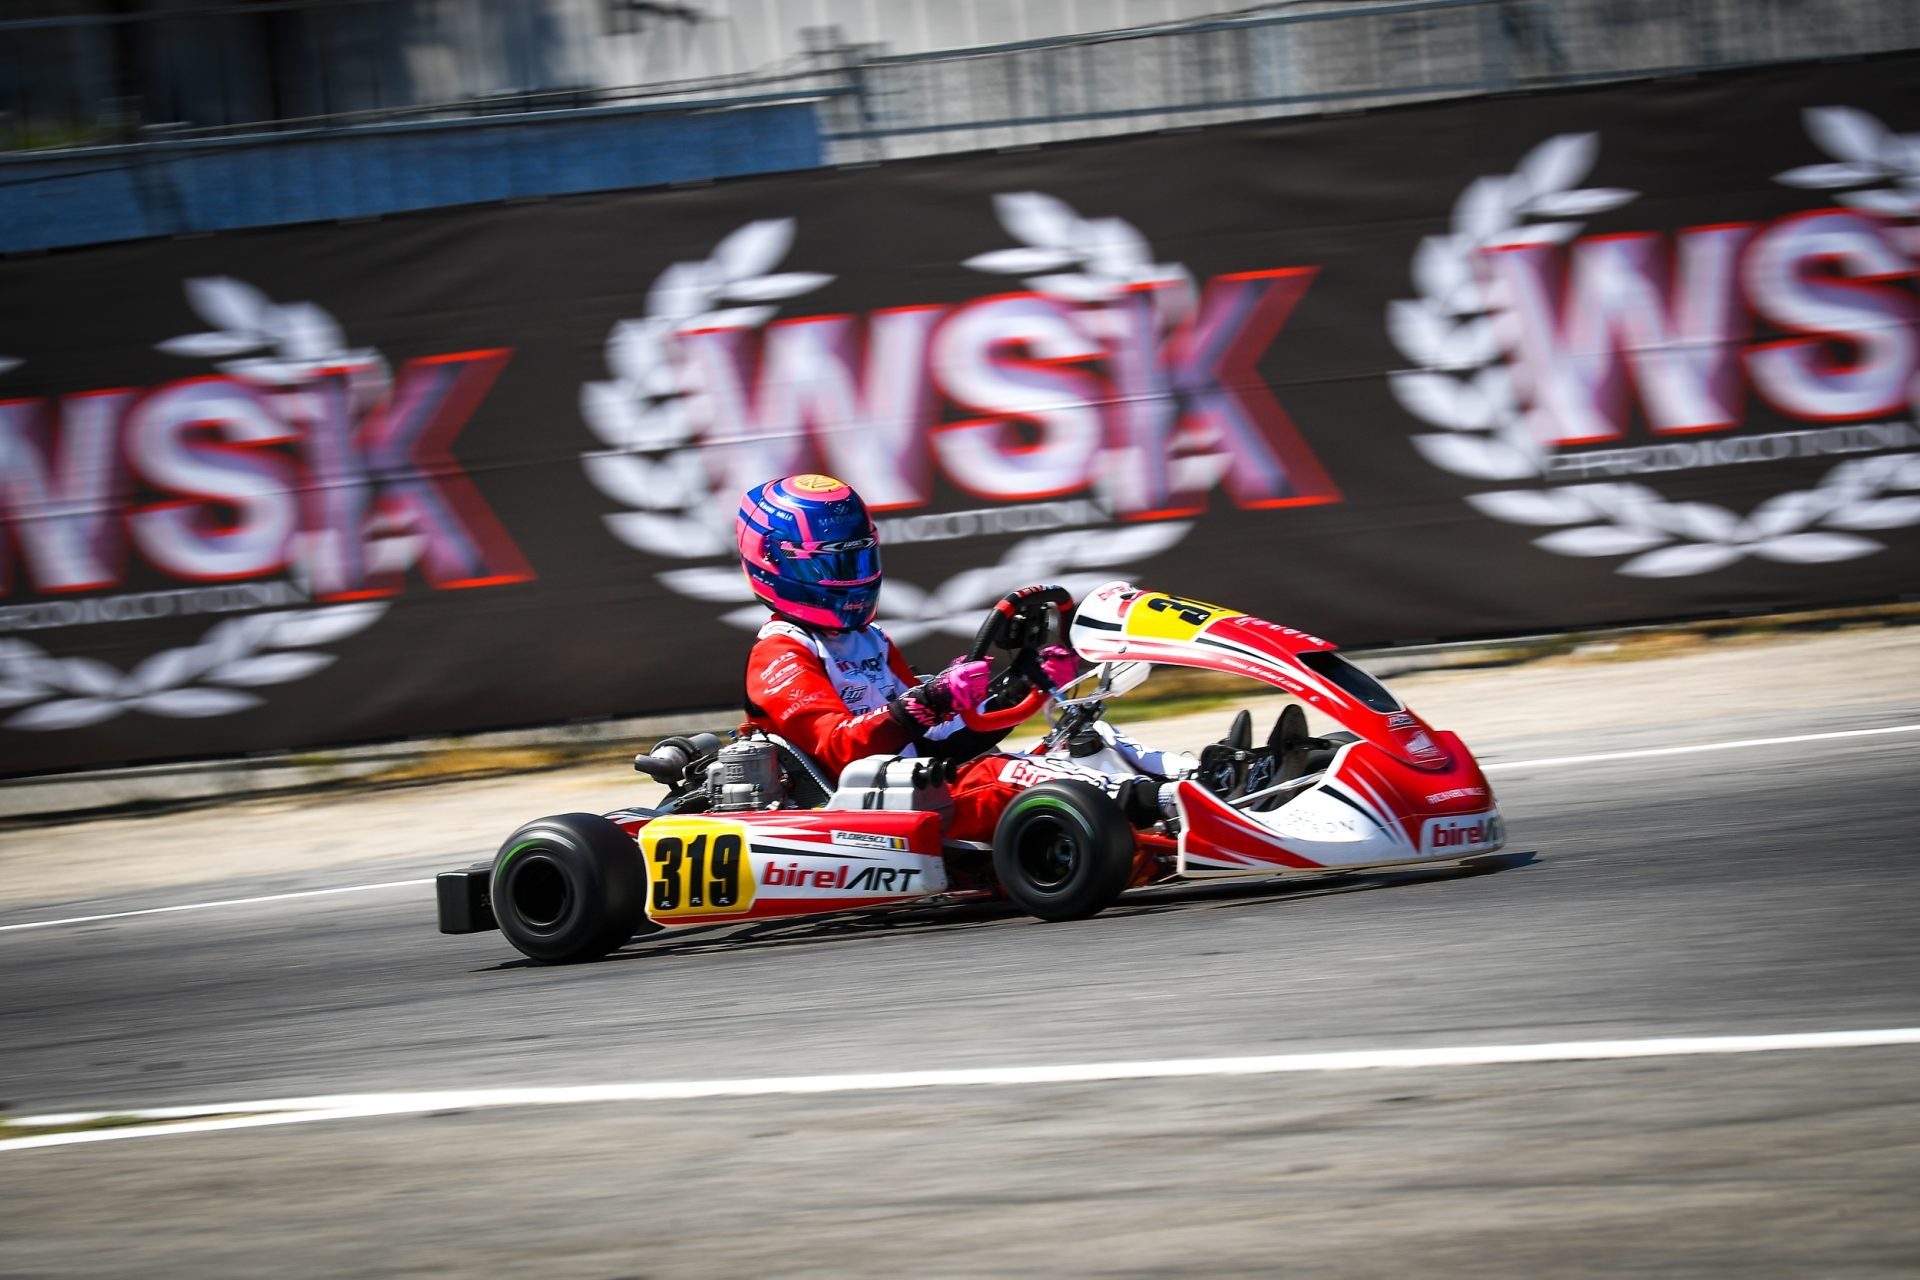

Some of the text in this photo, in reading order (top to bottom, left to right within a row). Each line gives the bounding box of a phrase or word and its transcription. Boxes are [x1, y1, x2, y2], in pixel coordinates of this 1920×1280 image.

[676, 266, 1342, 522] WSK
[1479, 206, 1920, 447] WS
[653, 834, 742, 911] 319
[762, 861, 922, 892] birelART
